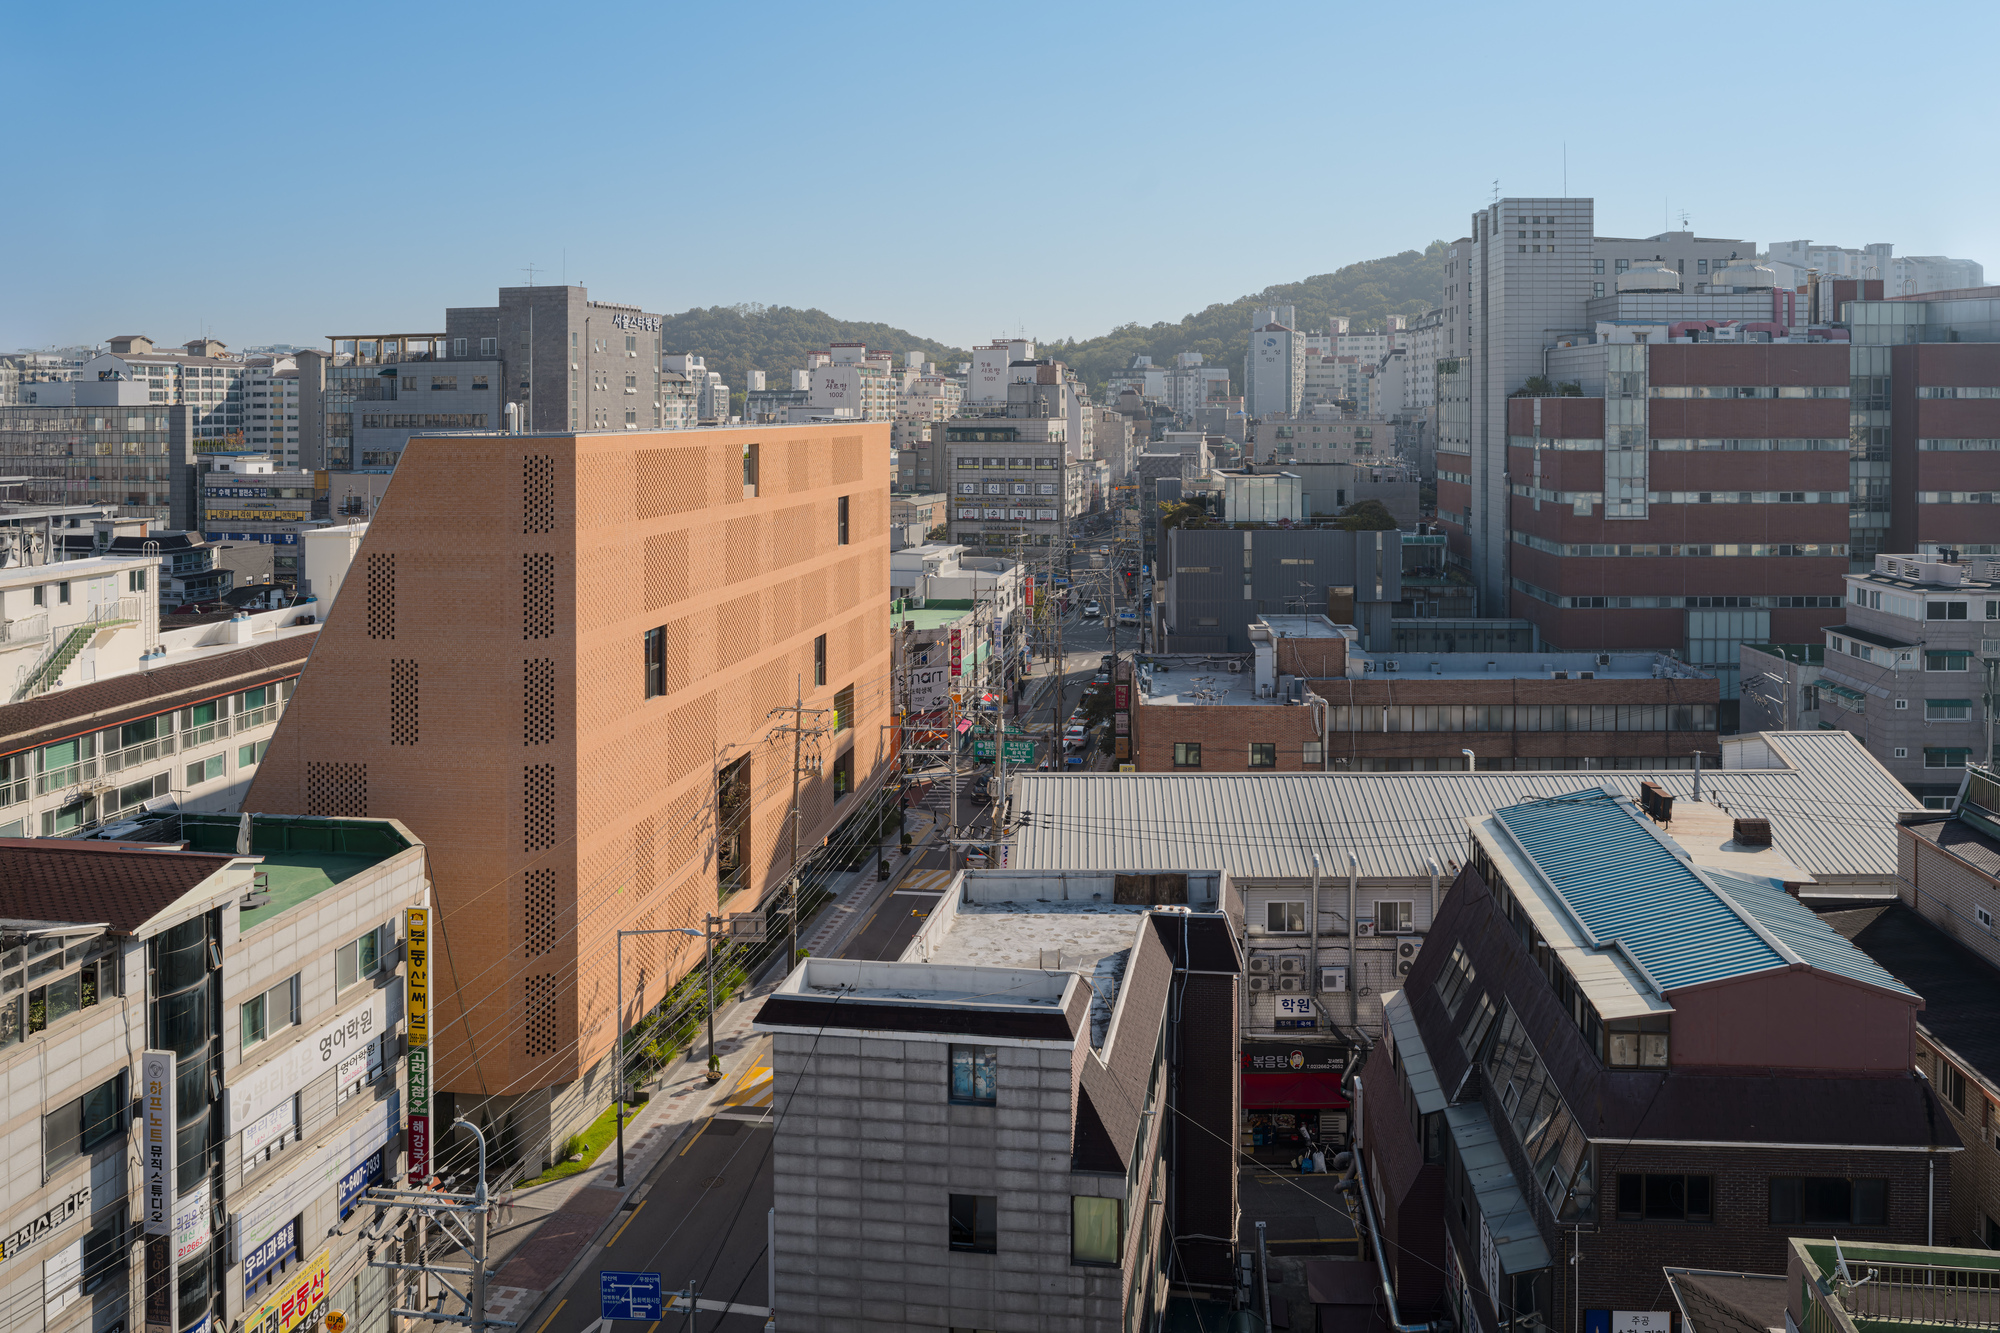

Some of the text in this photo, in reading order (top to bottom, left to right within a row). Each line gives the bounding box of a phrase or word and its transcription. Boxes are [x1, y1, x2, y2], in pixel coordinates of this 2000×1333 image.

[612, 313, 660, 332] 서울스타병원
[411, 929, 426, 1030] 부동산써브
[1281, 998, 1310, 1013] 학원
[319, 1008, 373, 1062] 영어학원
[341, 1043, 375, 1075] 영어학원
[411, 1051, 425, 1097] 고려서점
[150, 1080, 162, 1142] 하프노트
[246, 1104, 288, 1140] 뿌리깊은
[412, 1121, 425, 1175] 해강국어
[150, 1146, 164, 1222] 뮤직스튜디오
[340, 1153, 380, 1200] 02-6407-7933
[4, 1187, 92, 1261] 뮤직스튜디오
[246, 1229, 287, 1277] 우리과학
[281, 1267, 326, 1330] 부동산
[327, 1315, 344, 1323] 미래
[1631, 1315, 1650, 1327] 주공
